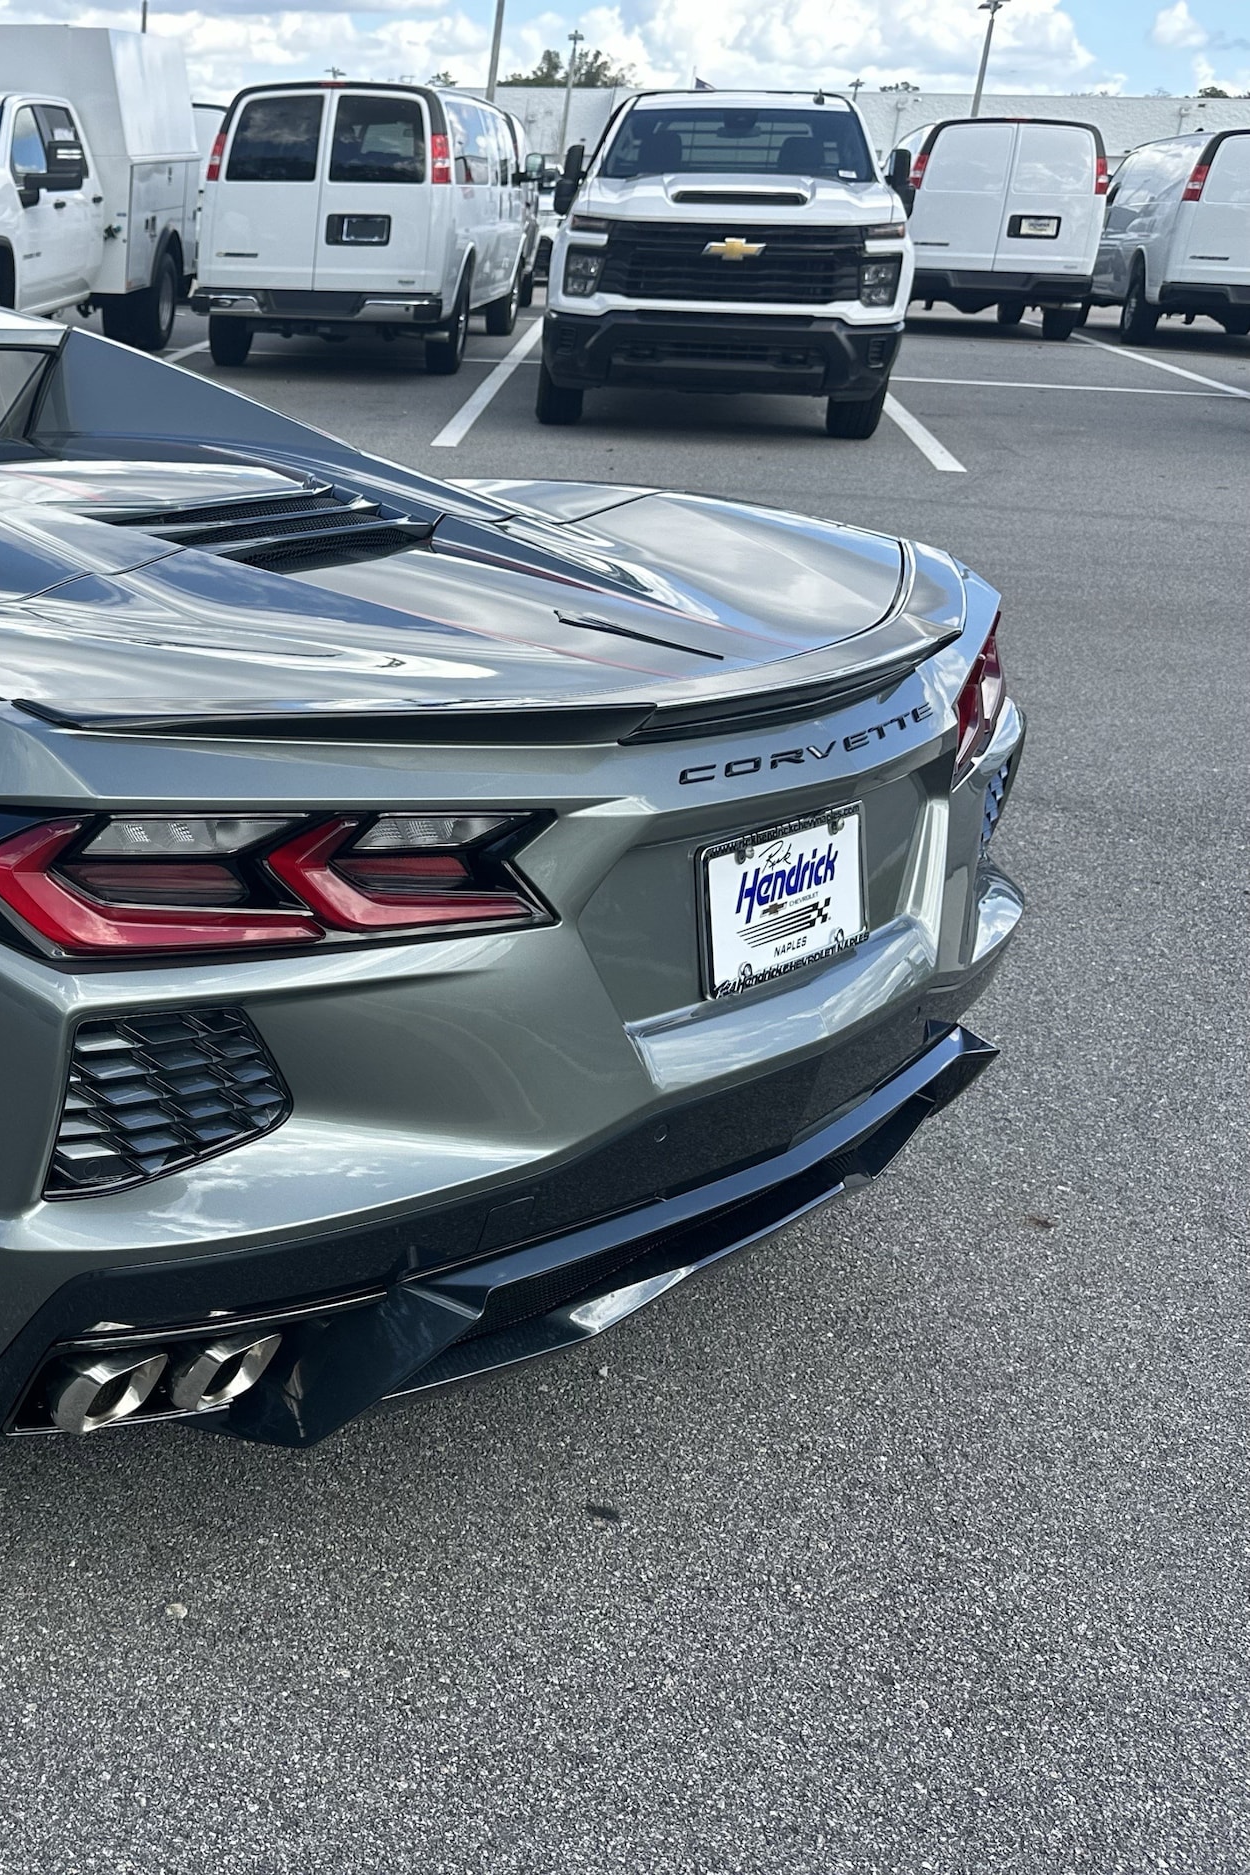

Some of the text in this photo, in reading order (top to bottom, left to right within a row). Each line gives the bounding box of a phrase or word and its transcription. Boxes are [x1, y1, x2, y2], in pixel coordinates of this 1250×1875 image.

[679, 702, 934, 785] CORVETTE
[735, 842, 839, 925] Hendrick
[789, 891, 819, 907] CHEVROLET
[773, 936, 808, 958] NAPLES
[836, 931, 870, 954] NAPLES
